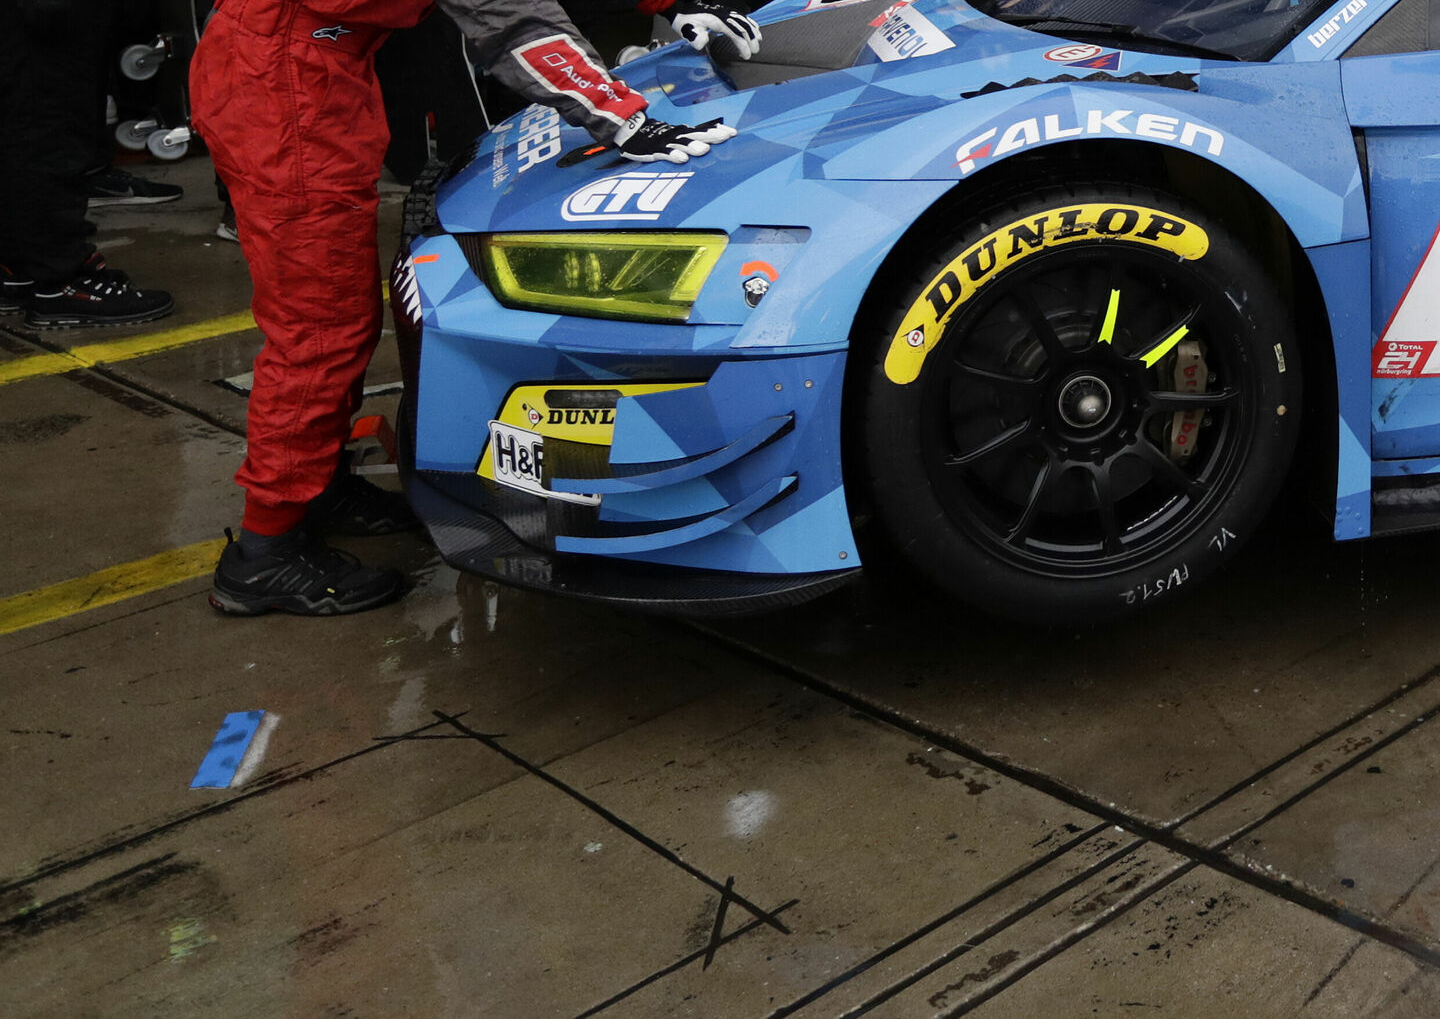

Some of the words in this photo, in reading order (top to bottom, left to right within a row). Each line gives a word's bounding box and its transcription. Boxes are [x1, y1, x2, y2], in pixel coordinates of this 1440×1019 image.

[951, 108, 1225, 175] FALKEN
[924, 207, 1187, 323] DUNLOP
[1398, 343, 1424, 351] TOTAL
